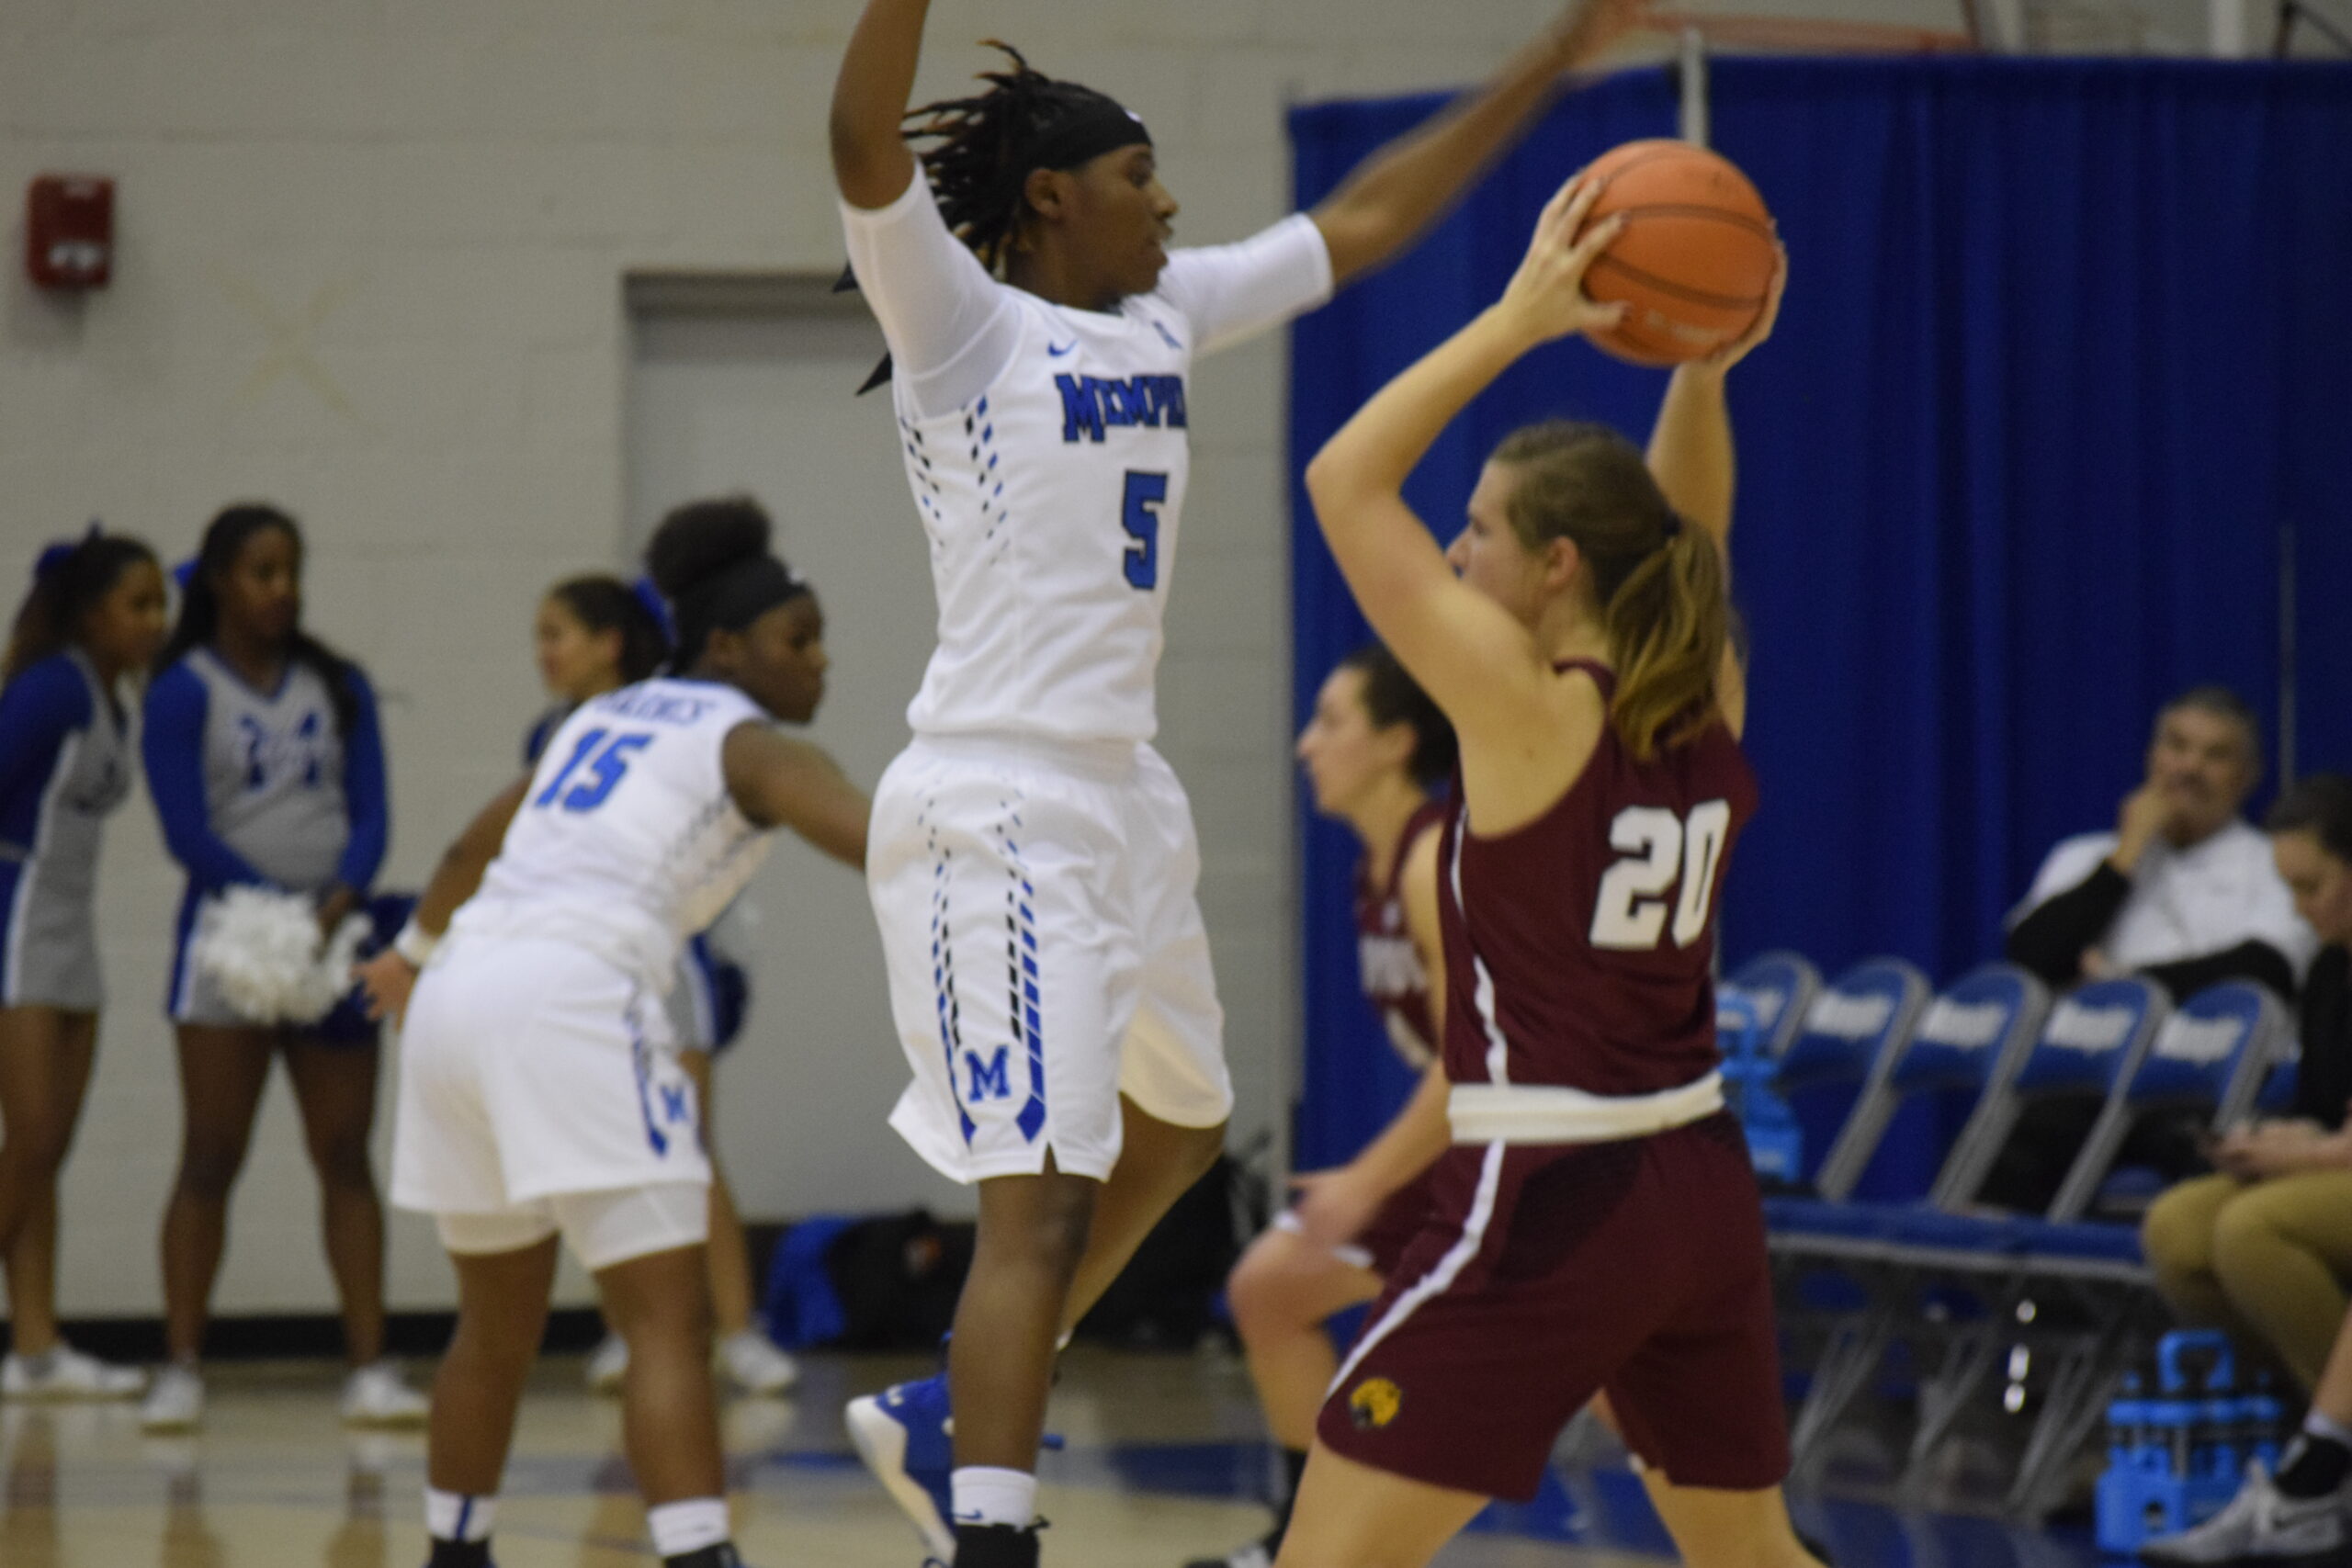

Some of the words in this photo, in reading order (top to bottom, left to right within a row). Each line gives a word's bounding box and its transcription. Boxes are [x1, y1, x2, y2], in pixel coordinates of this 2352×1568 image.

[1121, 469, 1168, 591] 5
[534, 728, 654, 812] 15
[1589, 797, 1731, 950] 20
[965, 1044, 1011, 1102] M
